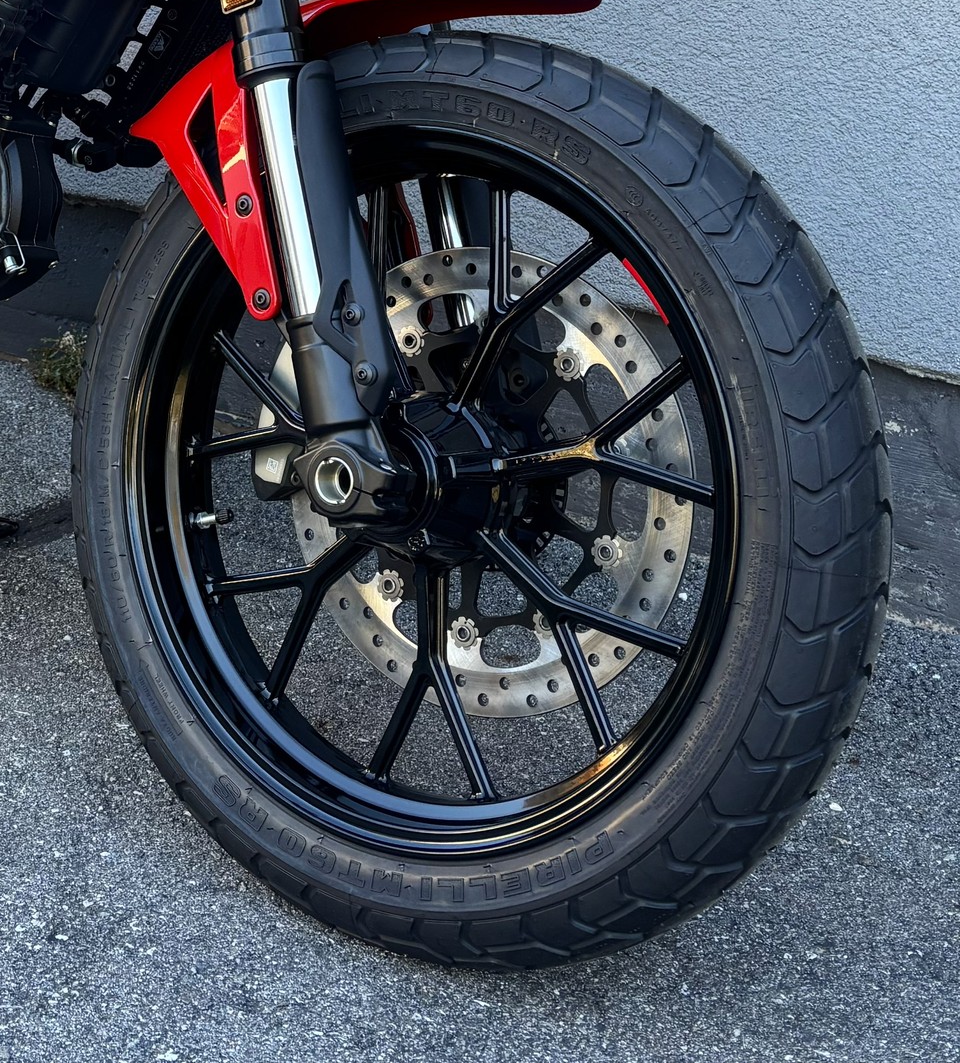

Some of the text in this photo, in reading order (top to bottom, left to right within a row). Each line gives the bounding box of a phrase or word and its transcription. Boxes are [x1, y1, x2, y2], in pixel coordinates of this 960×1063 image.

[529, 119, 593, 166] RS
[213, 774, 615, 903] PIRELLI MT60 RS
